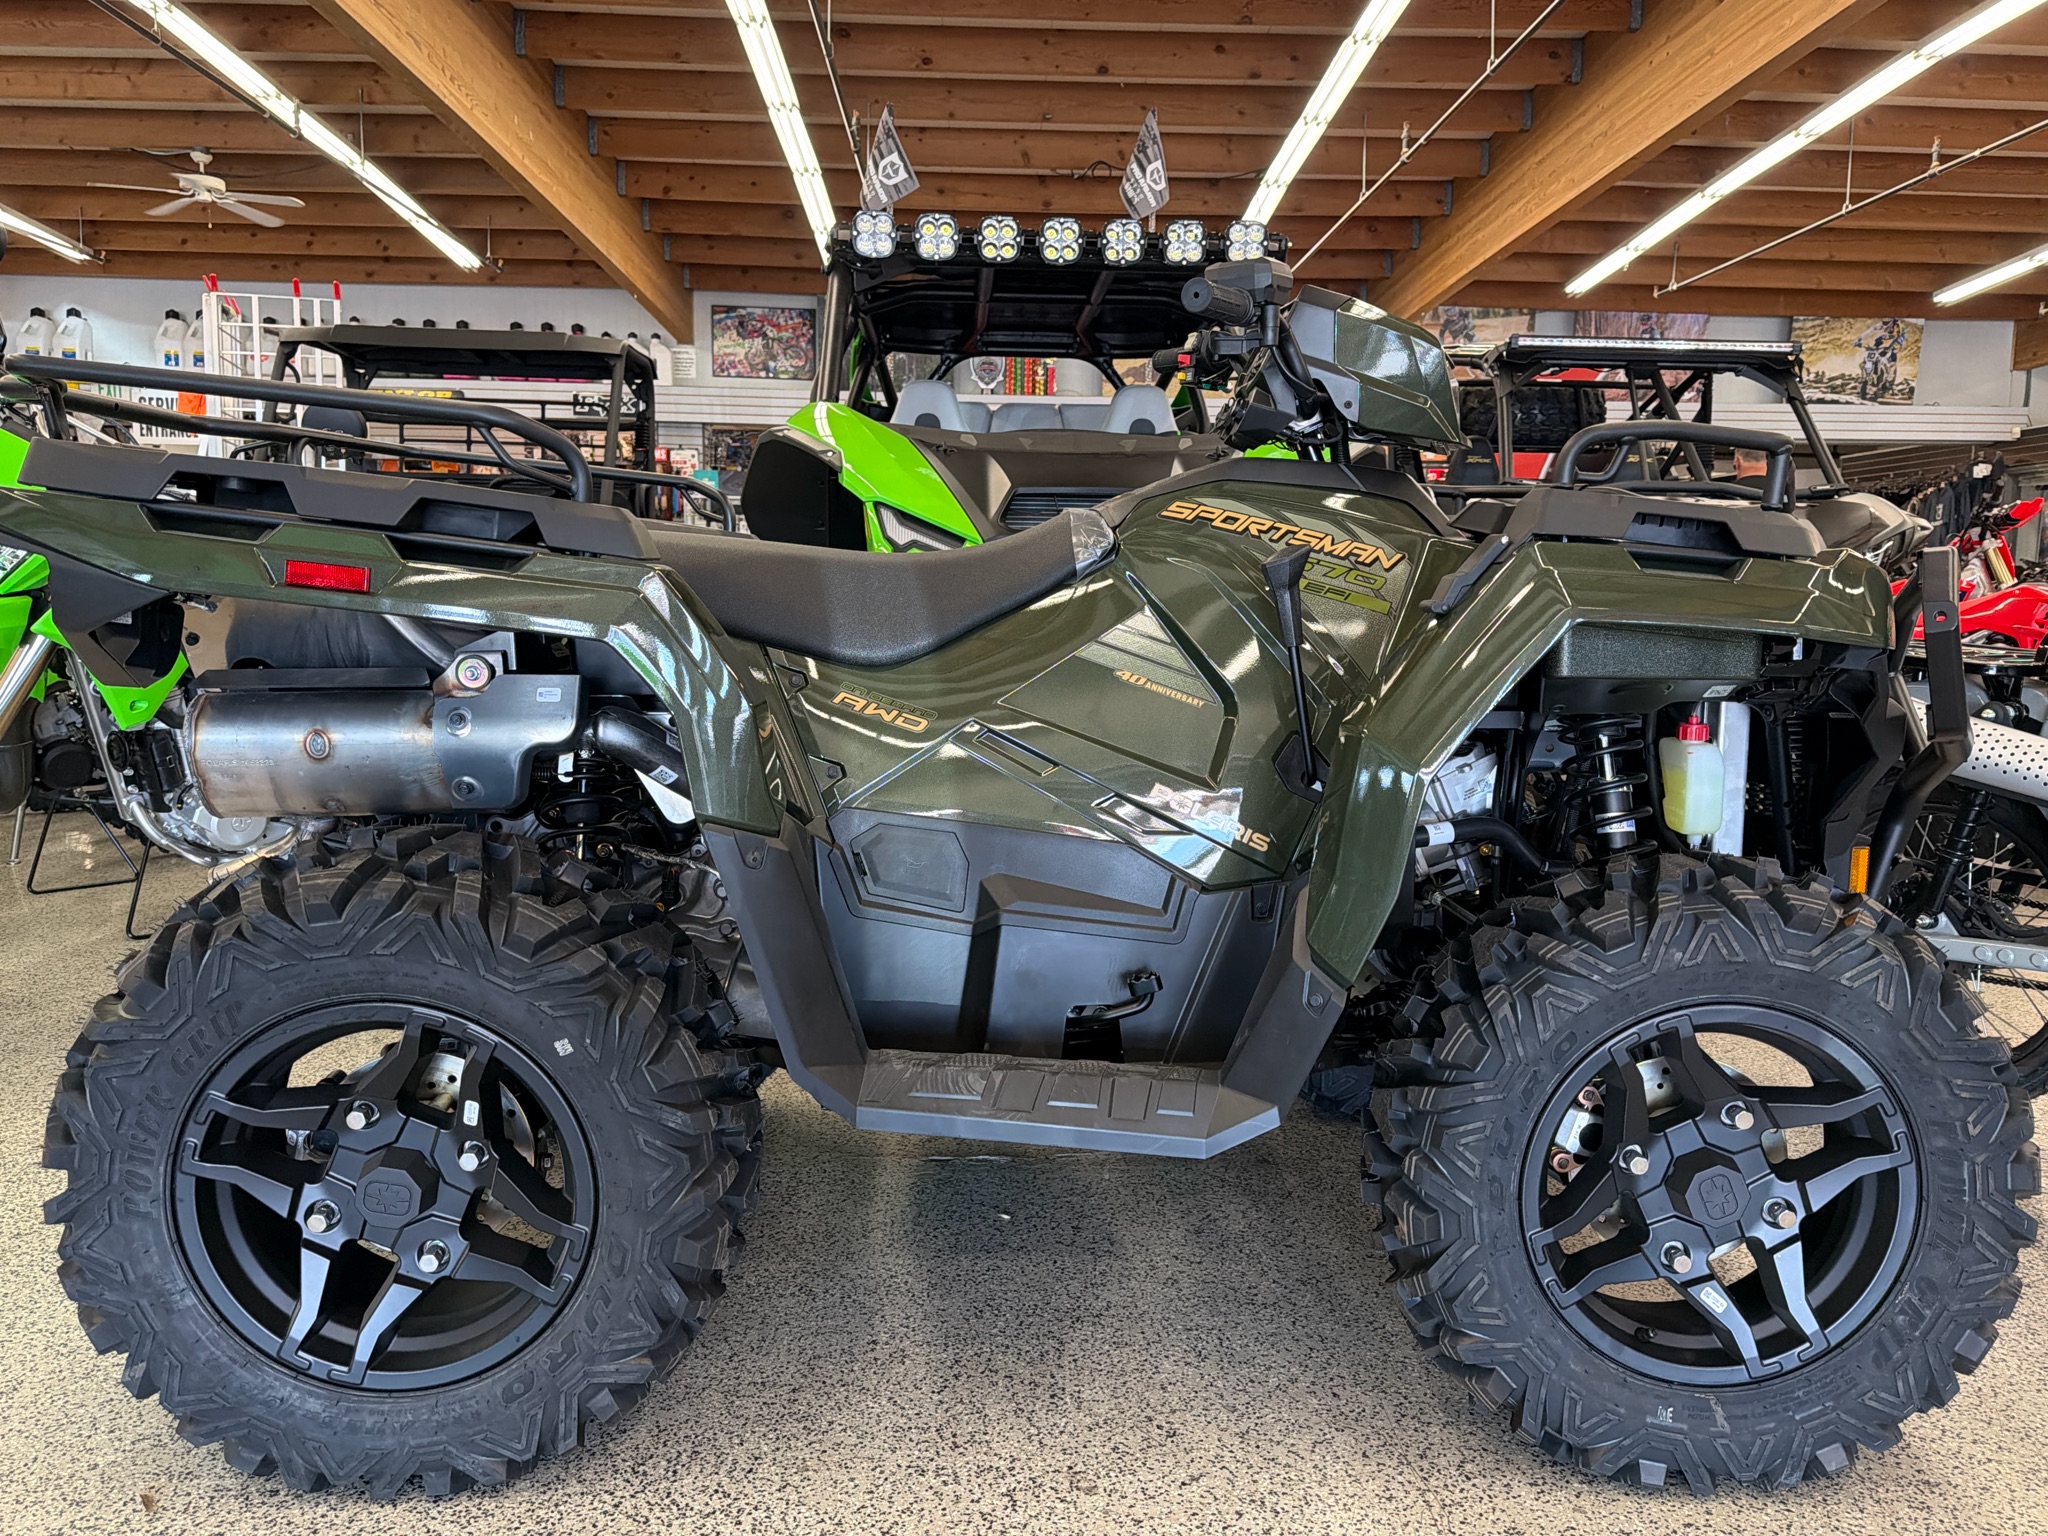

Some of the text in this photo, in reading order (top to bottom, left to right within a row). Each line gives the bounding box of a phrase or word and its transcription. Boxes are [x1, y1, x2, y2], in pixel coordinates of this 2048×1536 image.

[1138, 178, 1157, 208] ARMOR
[1161, 501, 1406, 570] SPORTSMAN
[1303, 582, 1352, 601] EFI
[841, 682, 937, 719] ON DEMAND
[1114, 668, 1206, 709] 40 ANNIVERSARY
[831, 691, 930, 732] AWD
[1149, 782, 1271, 852] POLARIS
[119, 999, 246, 1220] POWER GRIP
